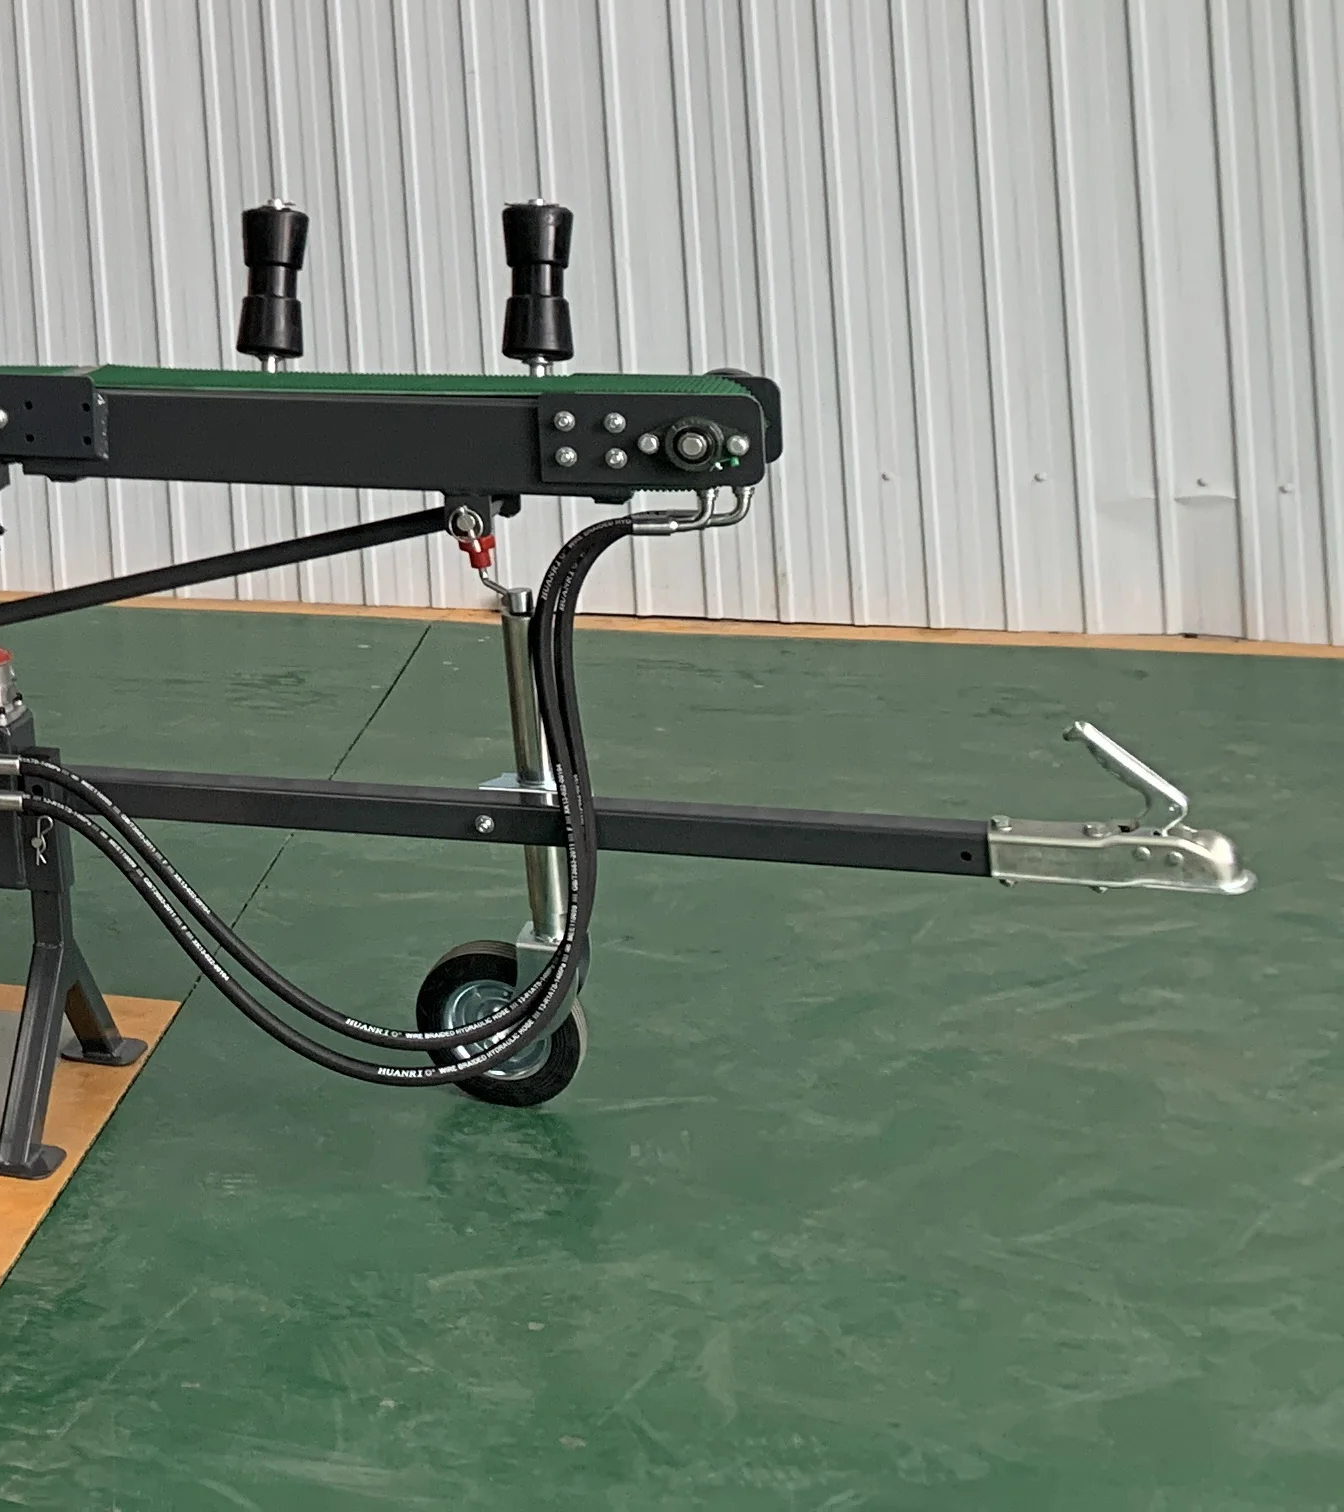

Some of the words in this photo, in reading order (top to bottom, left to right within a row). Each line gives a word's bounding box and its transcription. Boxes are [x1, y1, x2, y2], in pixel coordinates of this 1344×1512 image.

[345, 1018, 391, 1037] HUANRI
[405, 1032, 424, 1040] WIRE
[424, 1029, 455, 1040] BRAIDED
[455, 1017, 493, 1038] HYDRAULIC
[492, 1007, 510, 1022] HOSE
[377, 1066, 423, 1078] HUANRI
[438, 1063, 458, 1075] WIRE
[457, 1053, 488, 1071] BRAIDED
[487, 1032, 520, 1059] HYDRAULIC
[518, 1019, 535, 1036] HOSE
